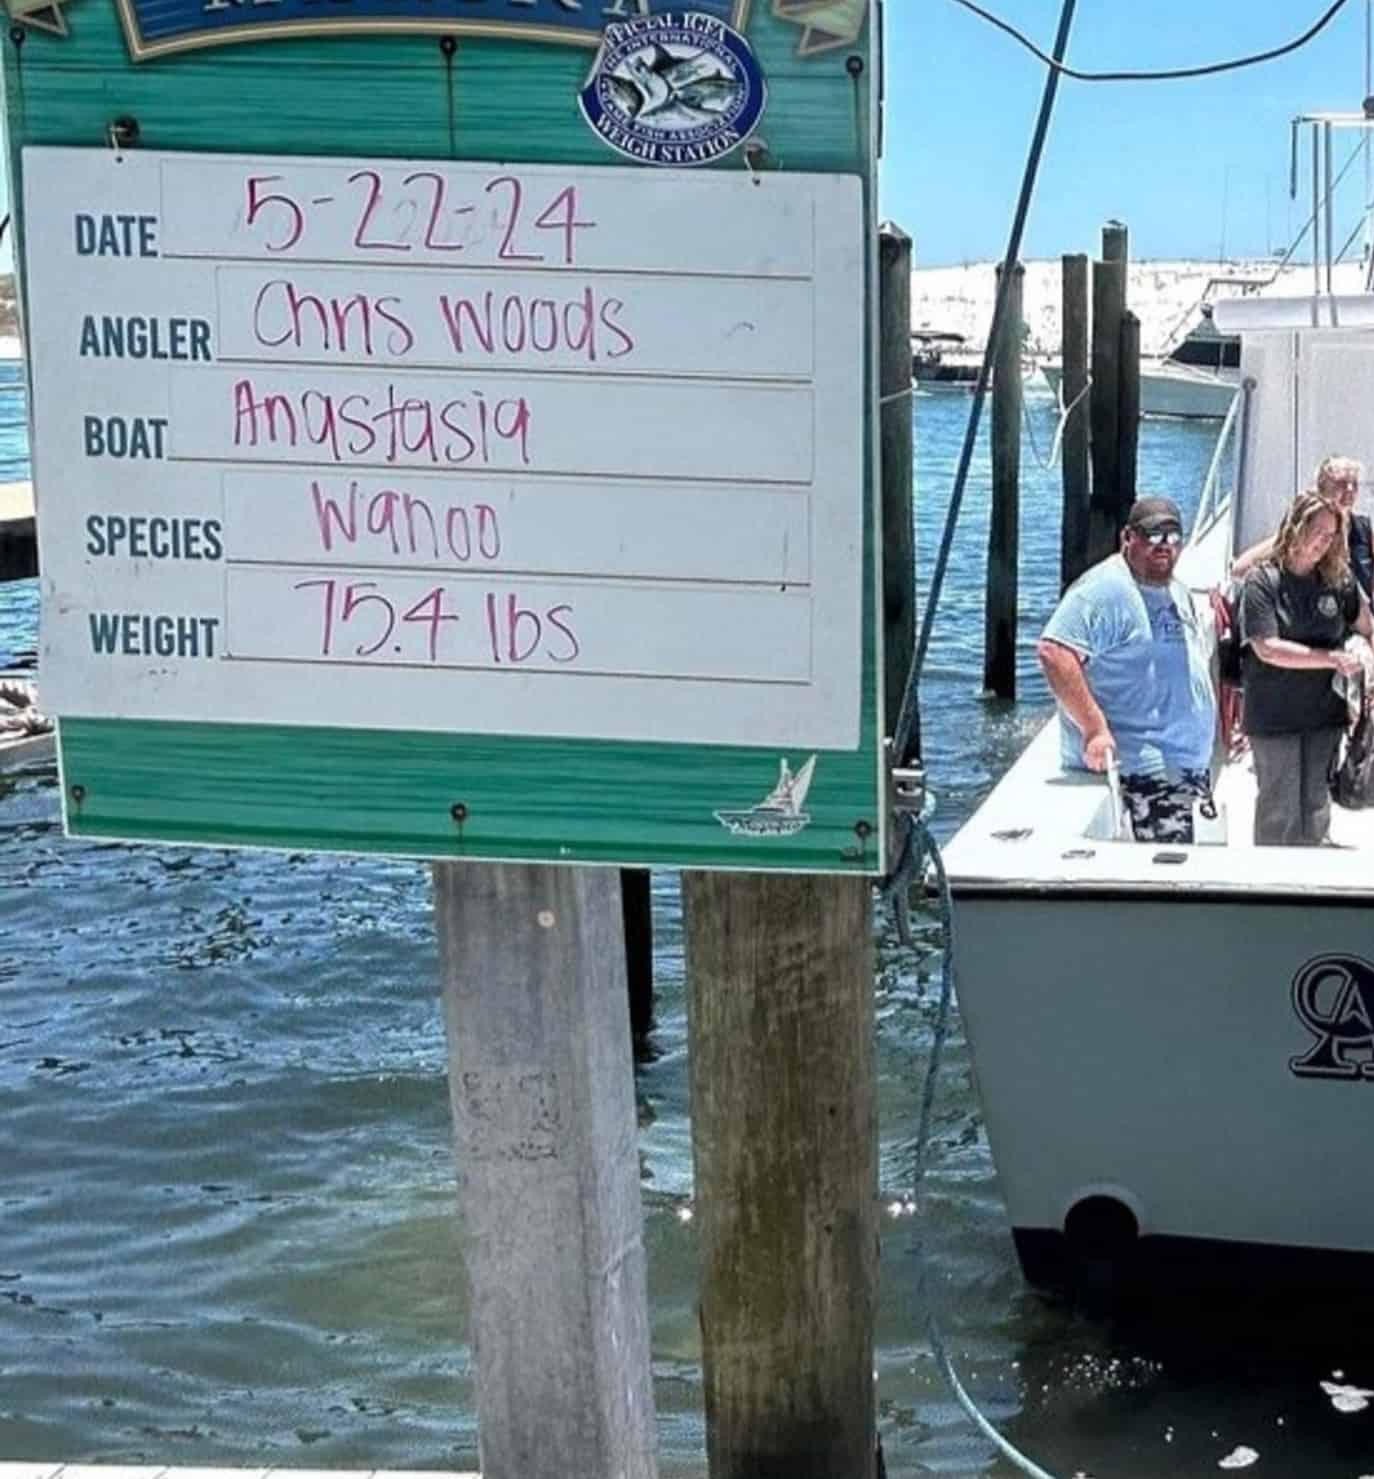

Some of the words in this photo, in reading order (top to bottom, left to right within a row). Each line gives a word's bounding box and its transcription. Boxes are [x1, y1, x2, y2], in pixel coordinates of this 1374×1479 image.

[683, 12, 726, 41] IGFA
[596, 113, 657, 160] WEIGH
[660, 124, 741, 163] STATION
[75, 214, 158, 258] DATE
[244, 170, 597, 265] 5-22-24
[79, 316, 212, 362] ANGLER
[84, 415, 169, 460] BOAT
[232, 379, 531, 465] Anastasia
[86, 515, 222, 561] SPECIES
[89, 613, 219, 658] WEIGHT
[293, 579, 460, 661] 75.4
[487, 592, 579, 663] lbs
